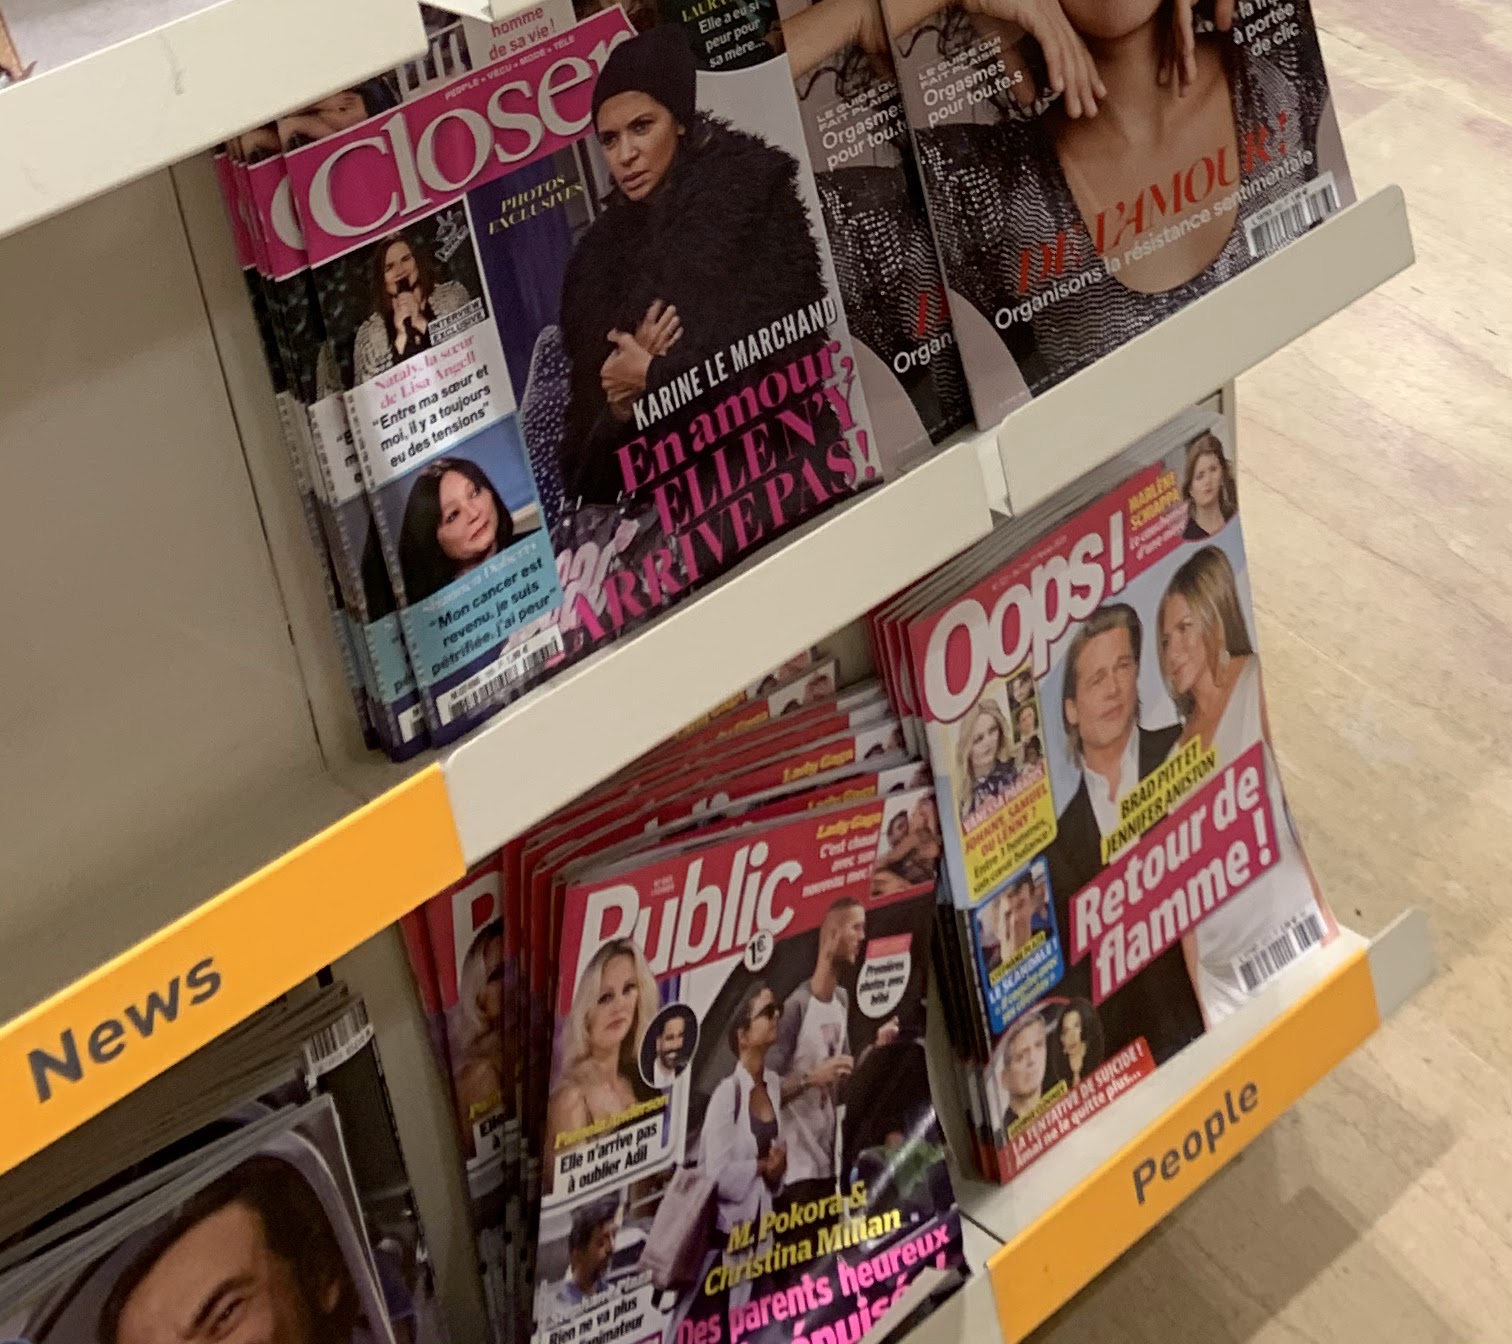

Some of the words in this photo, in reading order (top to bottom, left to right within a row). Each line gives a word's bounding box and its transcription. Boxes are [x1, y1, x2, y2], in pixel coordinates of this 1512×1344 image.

[490, 5, 544, 39] homme
[1245, 1, 1296, 40] portée
[1250, 35, 1272, 58] de
[1271, 20, 1301, 47] clic
[308, 26, 634, 241] Closer
[923, 58, 1007, 107] Orgasmes
[926, 96, 966, 130] pour
[488, 182, 585, 237] EXCLUSIVES
[500, 174, 567, 214] PHOTOS
[994, 263, 1103, 331] Organisons
[1123, 211, 1213, 267] résistance
[1213, 149, 1315, 218] sentimentale
[611, 430, 689, 496] En
[688, 339, 855, 454] amour,
[632, 365, 705, 432] KARINE
[704, 350, 729, 388] LE
[729, 296, 839, 375] MARCHAND
[650, 423, 777, 537] ELLE
[573, 488, 764, 643] ARRIVE
[763, 438, 857, 531] PAS
[923, 509, 1128, 726] Oops!
[1104, 800, 1165, 854] JENNIFER
[1164, 753, 1217, 809] ANISTON
[1119, 782, 1157, 819] BRAD
[1156, 758, 1185, 791] PITT
[1184, 741, 1200, 764] ET
[1075, 804, 1207, 954] Retour
[1211, 765, 1261, 832] de
[1096, 838, 1251, 998] flamme
[1251, 807, 1272, 867] !
[573, 841, 803, 1005] Public
[26, 955, 224, 1105] News
[560, 1152, 585, 1175] Elle
[586, 1130, 635, 1164] n'arrive
[635, 1122, 658, 1146] pas
[567, 1174, 576, 1194] à
[578, 1157, 621, 1188] oublier
[624, 1145, 648, 1170] Adil
[1131, 1078, 1262, 1207] People
[703, 1239, 813, 1298] Christina
[816, 1208, 902, 1254] Milian
[758, 1193, 845, 1243] Pokora
[728, 1272, 834, 1344] parents
[837, 1223, 951, 1299] heureux
